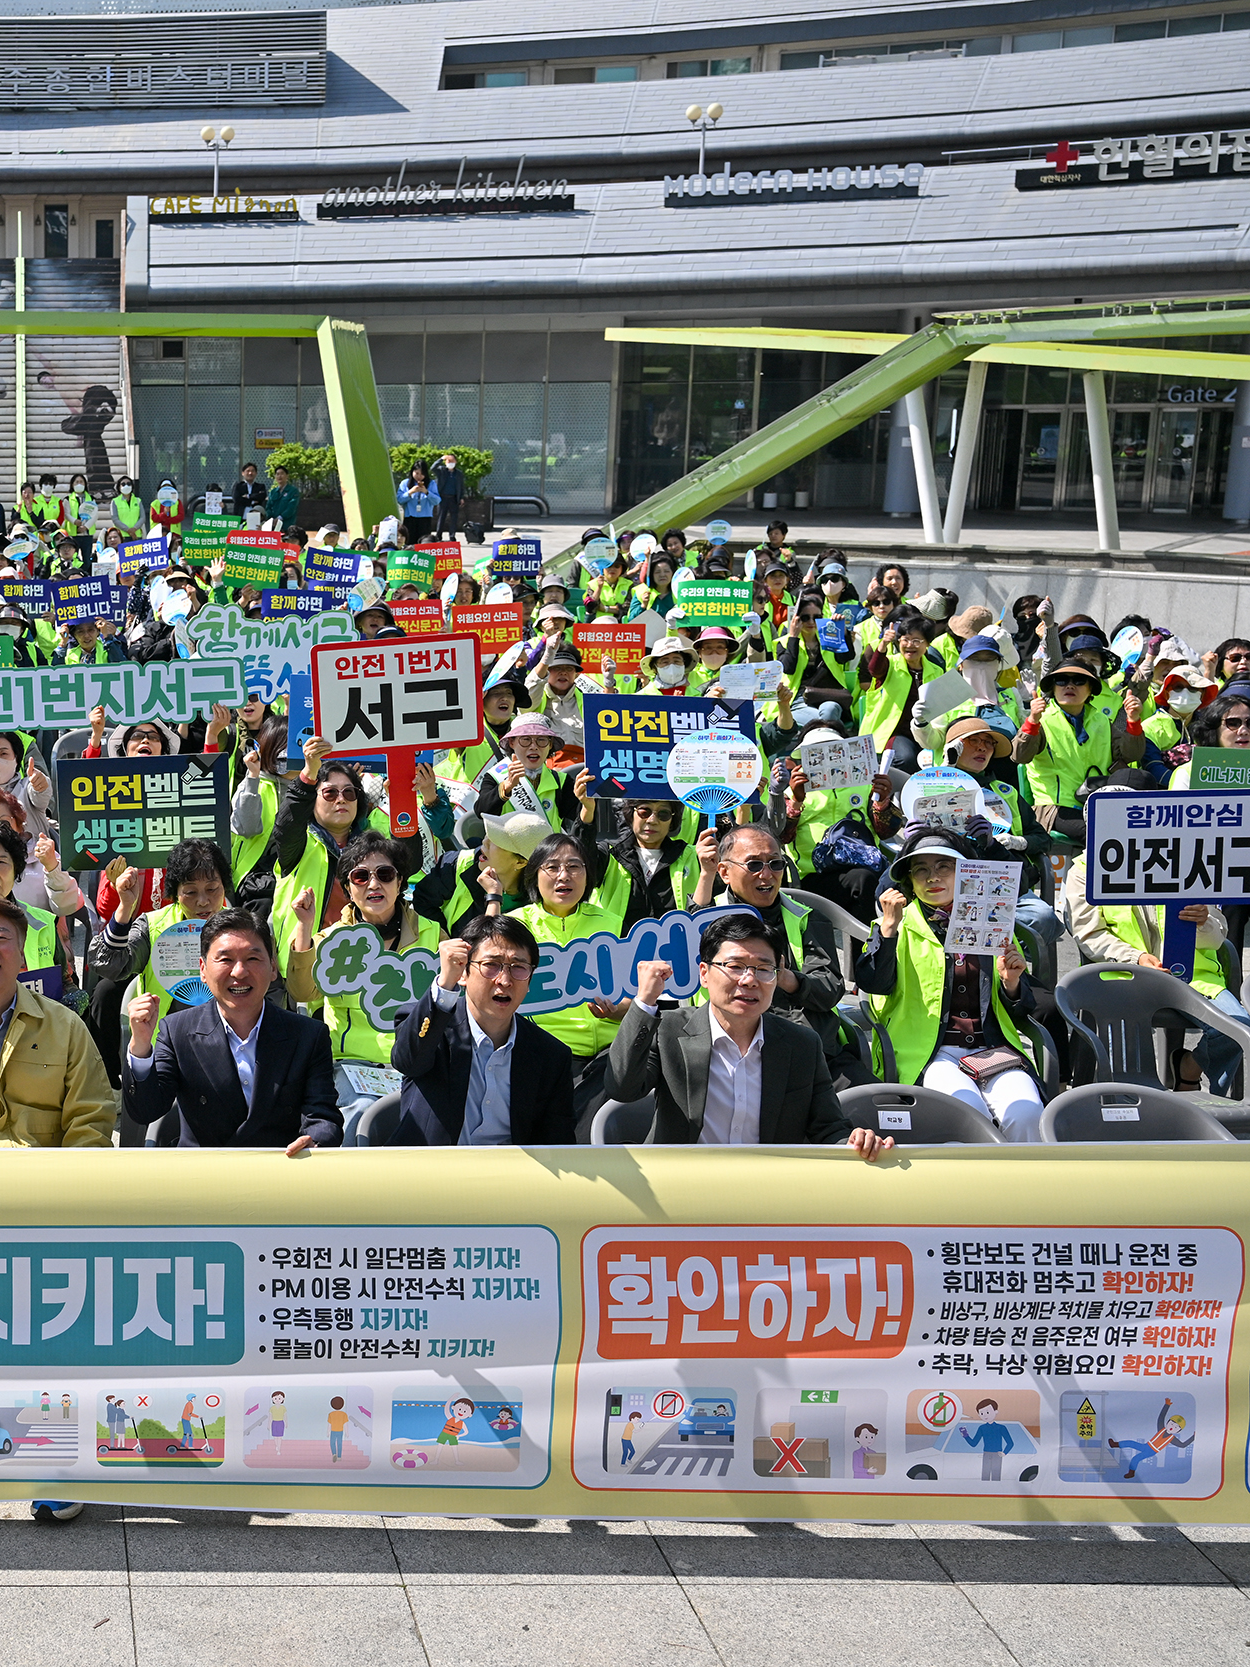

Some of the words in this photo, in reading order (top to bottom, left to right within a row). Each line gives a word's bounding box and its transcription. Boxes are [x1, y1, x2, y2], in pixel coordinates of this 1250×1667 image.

[322, 159, 440, 208] another
[451, 154, 569, 202] kitchen
[150, 196, 201, 214] CAFE
[1167, 385, 1217, 403] Gate
[124, 541, 161, 557] 함께하면
[498, 544, 536, 555] 함께하면
[313, 553, 354, 570] 함께하면
[494, 560, 540, 571] 안전합니다
[225, 564, 279, 583] 안전한바퀴
[3, 584, 44, 597] 함께하면
[58, 582, 102, 600] 함께하면
[680, 587, 704, 597] 우리의
[707, 587, 731, 597] 안전을
[733, 588, 749, 598] 위한
[57, 601, 111, 621] 안전합니다
[271, 595, 322, 612] 함께하면
[418, 606, 439, 615] 신고는
[680, 602, 749, 617] 안전한바퀴
[456, 612, 491, 624] 위험요인
[493, 611, 518, 622] 신고는
[577, 631, 612, 642] 위험요인
[615, 631, 641, 642] 신고는
[334, 654, 386, 680] 안전
[393, 648, 457, 674] 1번지
[335, 678, 463, 743] 서구
[1199, 766, 1246, 784] 에너지
[71, 767, 217, 812] 안전벨트
[1126, 803, 1243, 829] 함께안심
[72, 815, 217, 854] 생명벨트
[272, 1247, 332, 1270] 우회전
[338, 1247, 358, 1270] 시
[364, 1247, 447, 1270] 일단멈춤
[453, 1247, 521, 1270] 지키자!
[940, 1242, 1026, 1266] 횡단보도
[1031, 1242, 1073, 1266] 건널
[1080, 1242, 1123, 1266] 때나
[1128, 1242, 1170, 1266] 운전
[1177, 1242, 1197, 1266] 중
[271, 1277, 305, 1300] PM
[311, 1277, 351, 1300] 이용
[357, 1277, 377, 1300] 시
[383, 1277, 465, 1300] 안전수칙
[472, 1277, 540, 1300] 지키자!
[942, 1270, 1027, 1294] 휴대전화
[1033, 1270, 1095, 1294] 멈추고
[1102, 1270, 1194, 1294] 확인하자!
[607, 1253, 903, 1345] 확인하자!
[272, 1307, 354, 1331] 우측통행
[360, 1307, 428, 1331] 지키자!
[940, 1300, 989, 1321] 비상구,
[993, 1300, 1056, 1321] 비상계단
[1057, 1300, 1103, 1321] 적치물
[1105, 1300, 1153, 1321] 치우고
[1154, 1300, 1223, 1321] 확인하자!
[934, 1326, 969, 1348] 차량
[973, 1326, 1006, 1348] 탑승
[1010, 1326, 1028, 1348] 전
[1031, 1326, 1099, 1348] 음주운전
[1104, 1326, 1138, 1348] 여부
[1142, 1326, 1217, 1348] 확인하자!
[272, 1338, 333, 1359] 물놀이
[339, 1338, 421, 1359] 안전수칙
[426, 1338, 495, 1359] 지키자!
[931, 1353, 979, 1376] 추락,
[985, 1353, 1027, 1376] 낙상
[1032, 1353, 1115, 1376] 위험요인
[1121, 1353, 1212, 1376] 확인하자!
